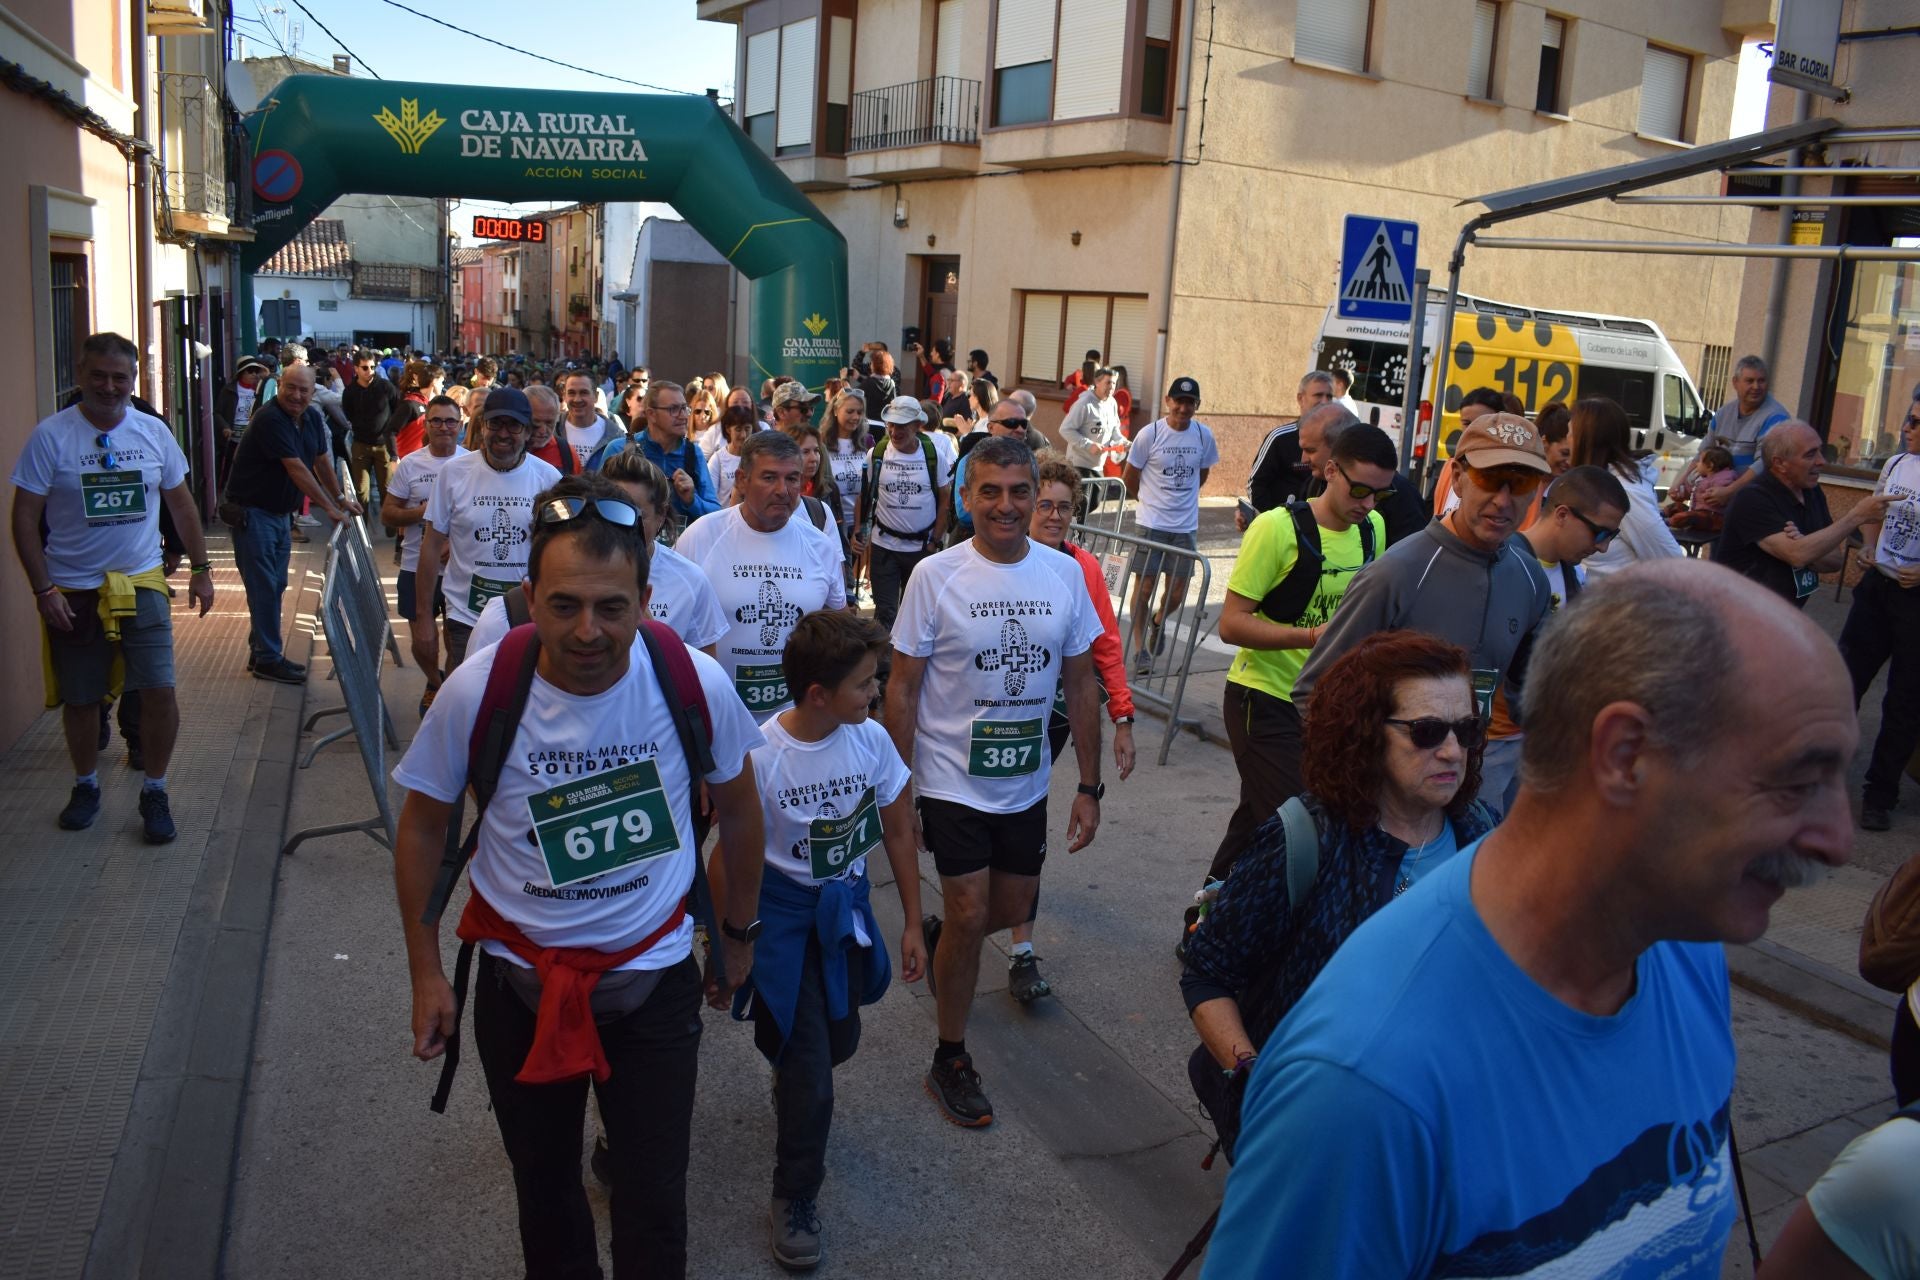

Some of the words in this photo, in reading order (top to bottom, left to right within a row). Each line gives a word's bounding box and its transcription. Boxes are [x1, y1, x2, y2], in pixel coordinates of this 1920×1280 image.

[1779, 50, 1796, 69] BAR
[1800, 57, 1829, 79] GLORIA
[460, 109, 533, 134] CAJA
[538, 112, 635, 136] RURAL
[460, 134, 501, 158] DE
[511, 137, 649, 161] NAVARRA
[525, 166, 583, 178] ACCIÓN
[591, 168, 647, 179] SOCIAL
[1346, 325, 1410, 338] ambulancia
[783, 348, 798, 357] DE
[800, 348, 842, 357] NAVARRA
[784, 338, 810, 348] CAJA
[812, 338, 841, 347] RURAL
[1494, 356, 1573, 412] 112
[93, 490, 135, 509] 267
[732, 564, 803, 573] CARRERA-MARCHA
[733, 571, 803, 580] SOLIDARIA
[970, 600, 1052, 610] CARRERA-MARCHA
[970, 608, 1053, 618] SOLIDARIA
[746, 683, 789, 704] 385
[528, 742, 659, 763] CARRERA-MARCHA
[983, 745, 1032, 768] 387
[566, 789, 585, 800] CAJA
[584, 783, 609, 794] RURAL
[579, 788, 613, 802] NAVARRA
[778, 773, 867, 800] CARRERA-MARCHA
[780, 782, 868, 809] SOLIDARIA
[564, 808, 653, 861] 679
